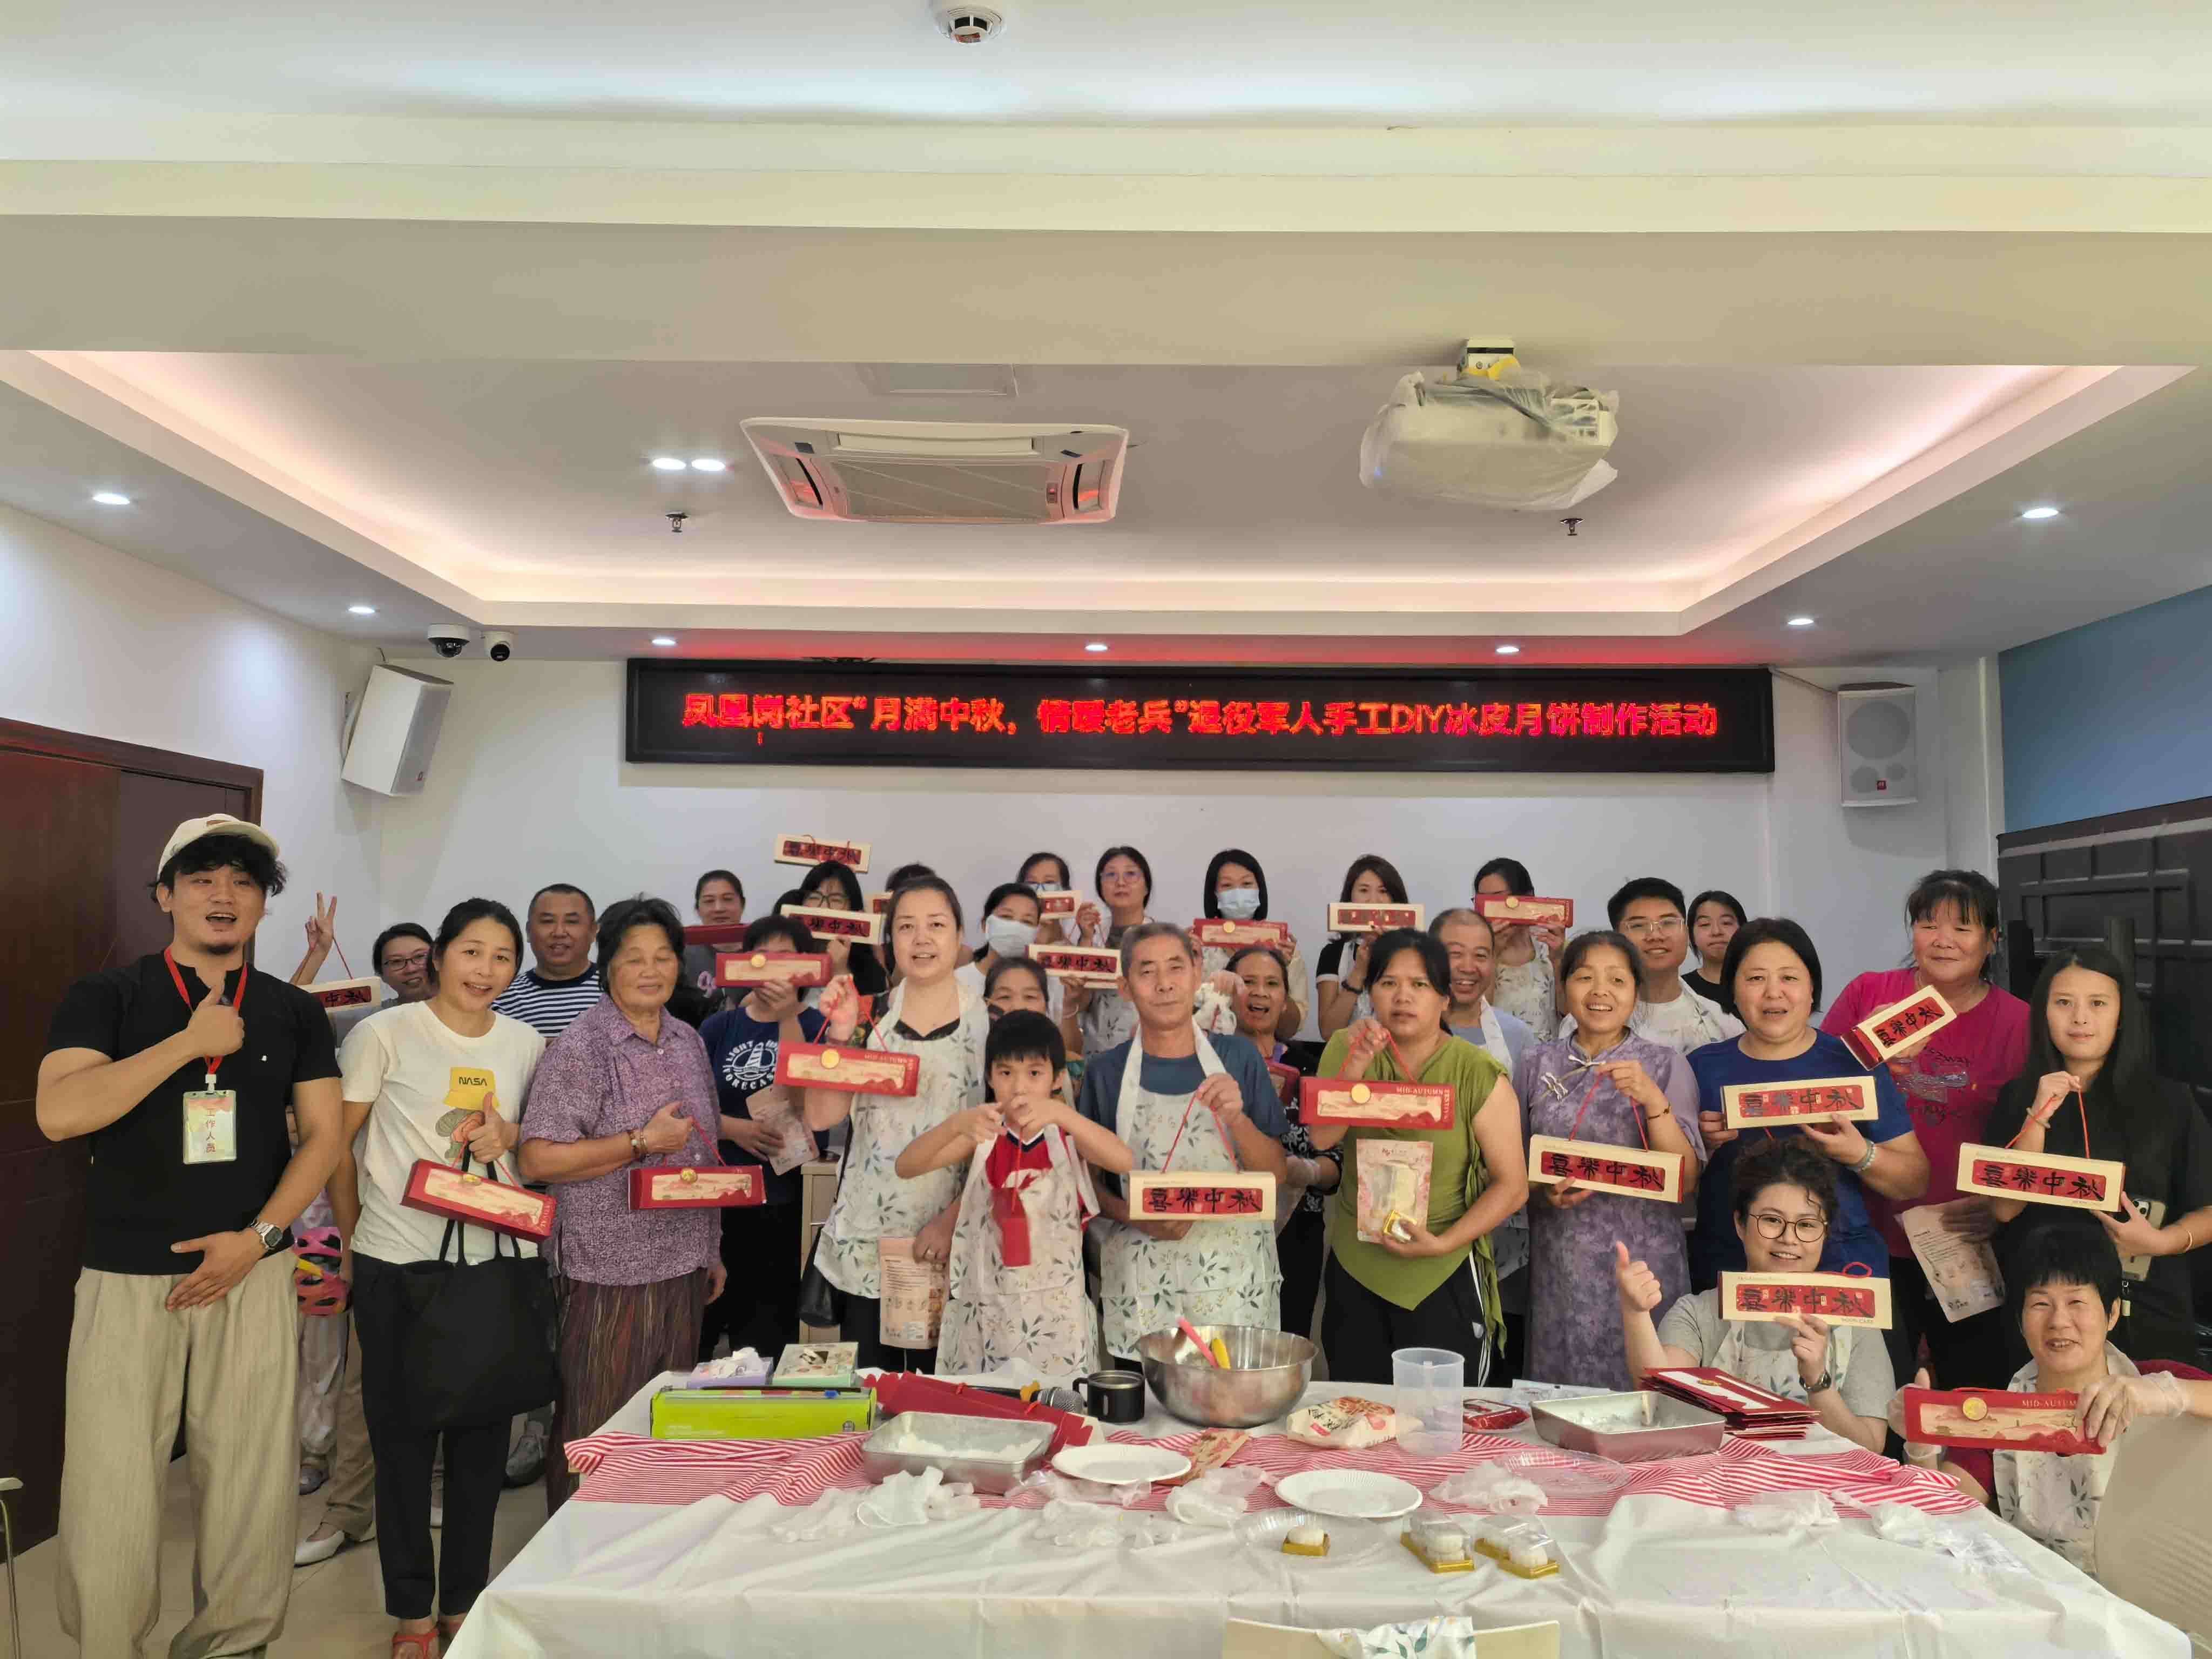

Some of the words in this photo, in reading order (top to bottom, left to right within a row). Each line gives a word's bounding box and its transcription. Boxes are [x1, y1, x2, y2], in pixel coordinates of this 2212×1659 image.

[458, 1076, 488, 1086] NASA
[206, 1108, 216, 1154] 工作人员
[2022, 1400, 2077, 1408] MID-AUTUM
